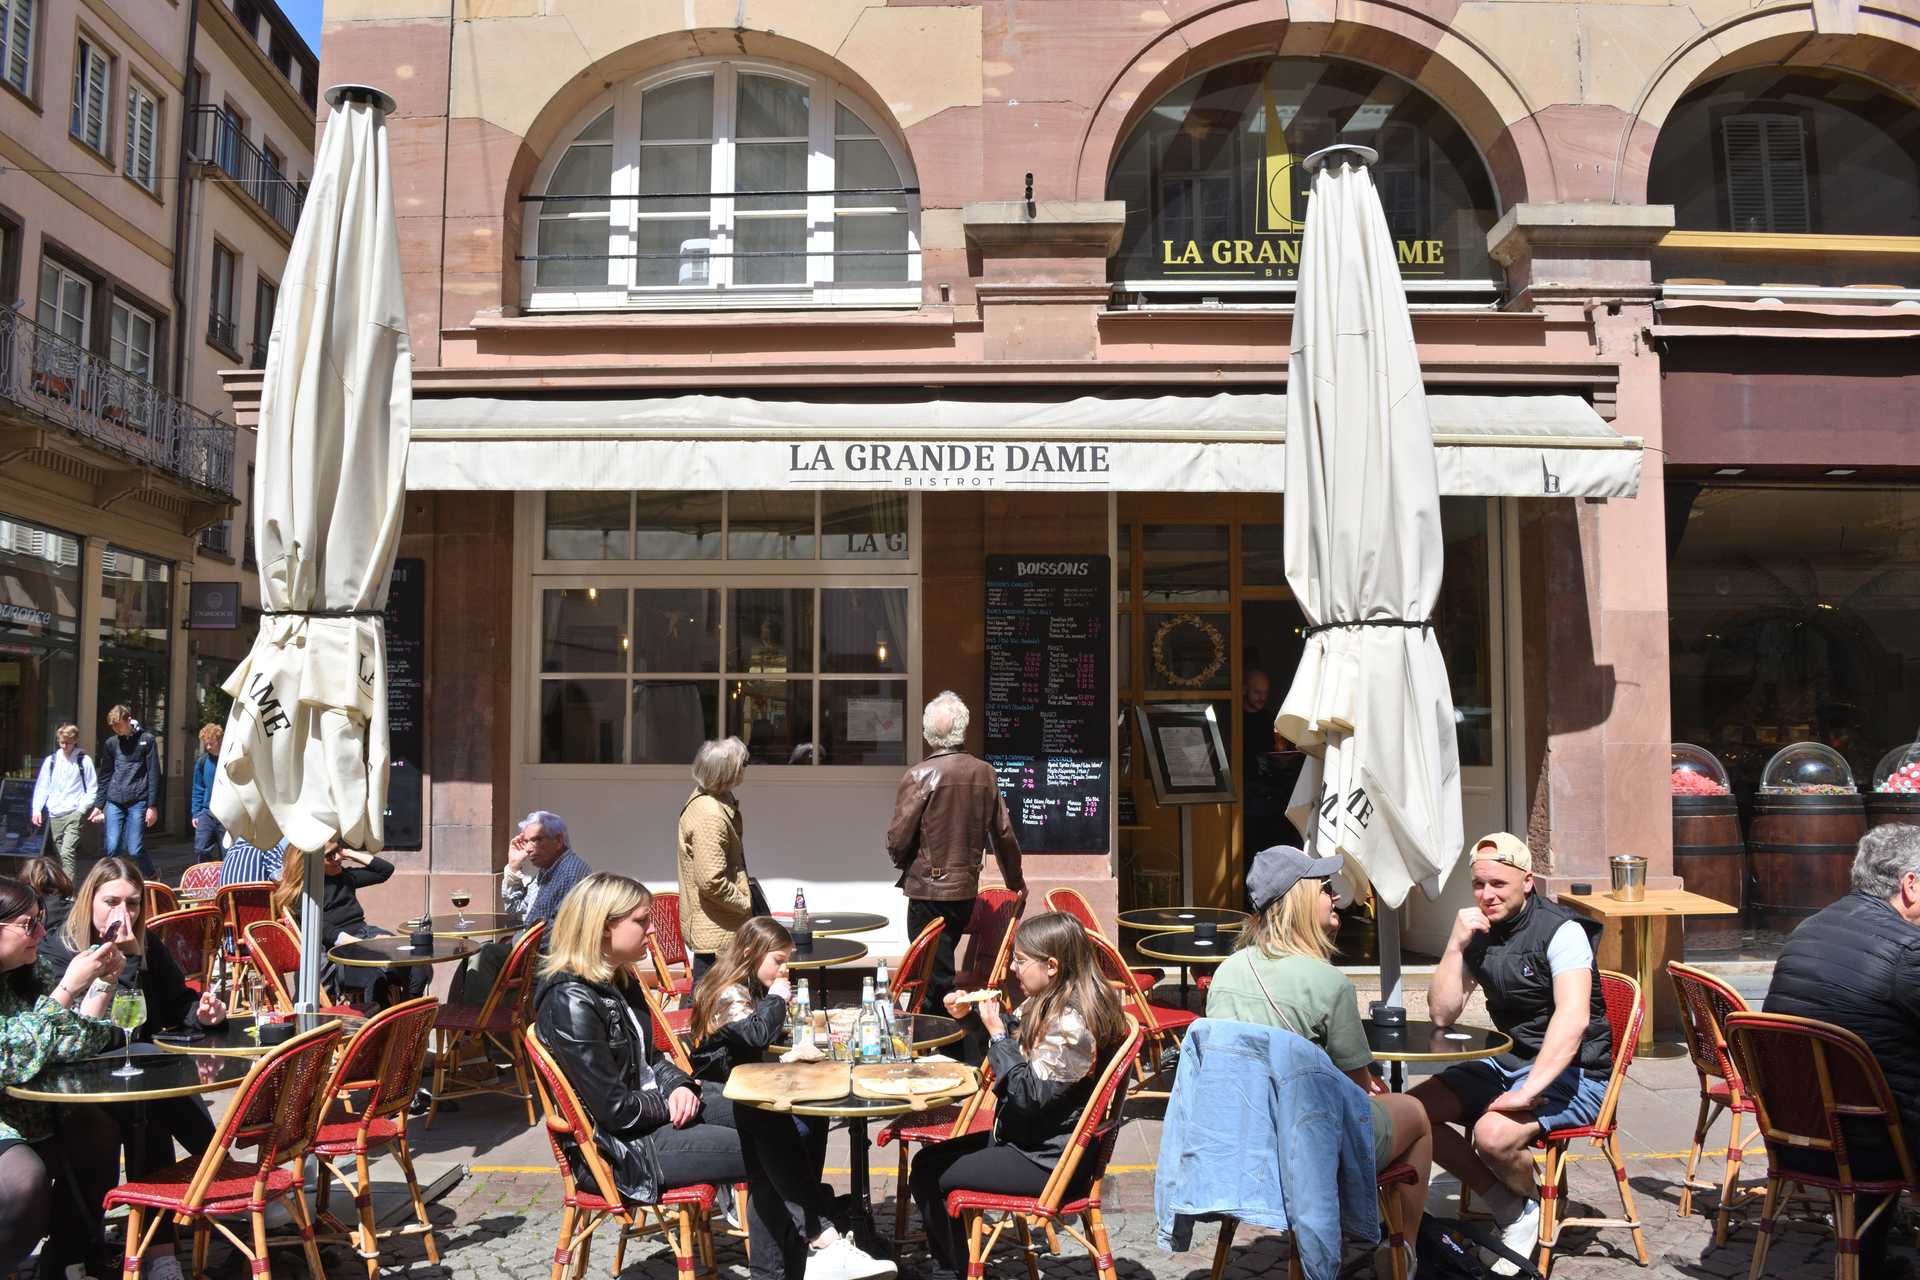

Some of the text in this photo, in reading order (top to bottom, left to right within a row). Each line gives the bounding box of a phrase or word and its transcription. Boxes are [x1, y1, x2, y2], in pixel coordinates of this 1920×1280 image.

[1163, 240, 1444, 264] LA GRAN ME
[1265, 268, 1294, 277] BIS
[789, 444, 1110, 473] LA GRANDE DAME
[904, 477, 995, 486] BISTROT
[847, 533, 878, 553] LA
[1017, 561, 1089, 576] BOISSONS
